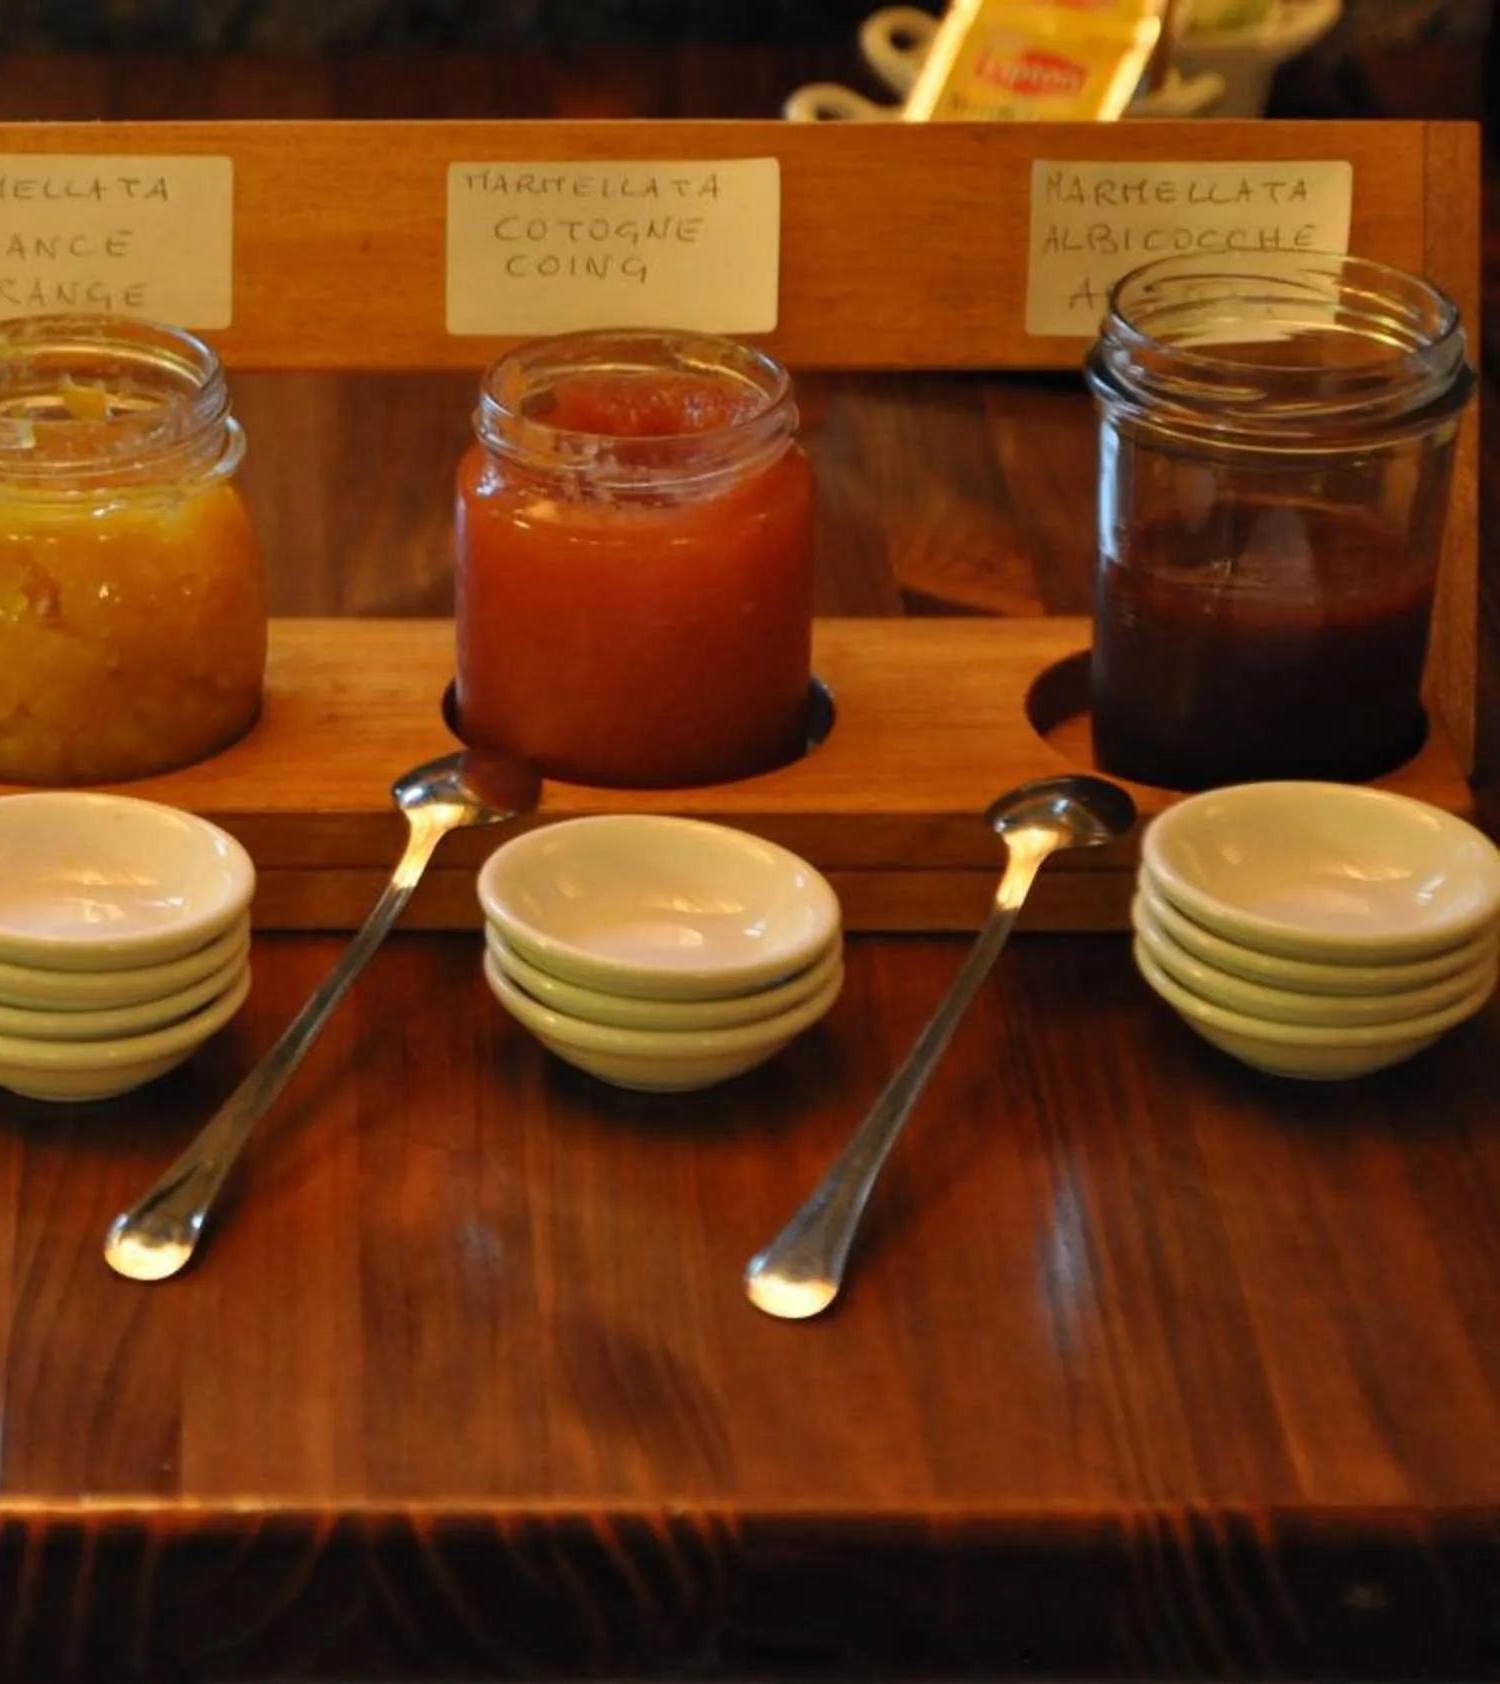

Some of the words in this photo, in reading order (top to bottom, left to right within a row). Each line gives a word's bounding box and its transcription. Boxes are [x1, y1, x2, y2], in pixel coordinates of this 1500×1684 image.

[1046, 171, 1311, 207] MARMELLATA
[493, 215, 705, 246] COTOGNE
[1042, 223, 1318, 254] ALBICOCCHE
[504, 254, 648, 284] COING
